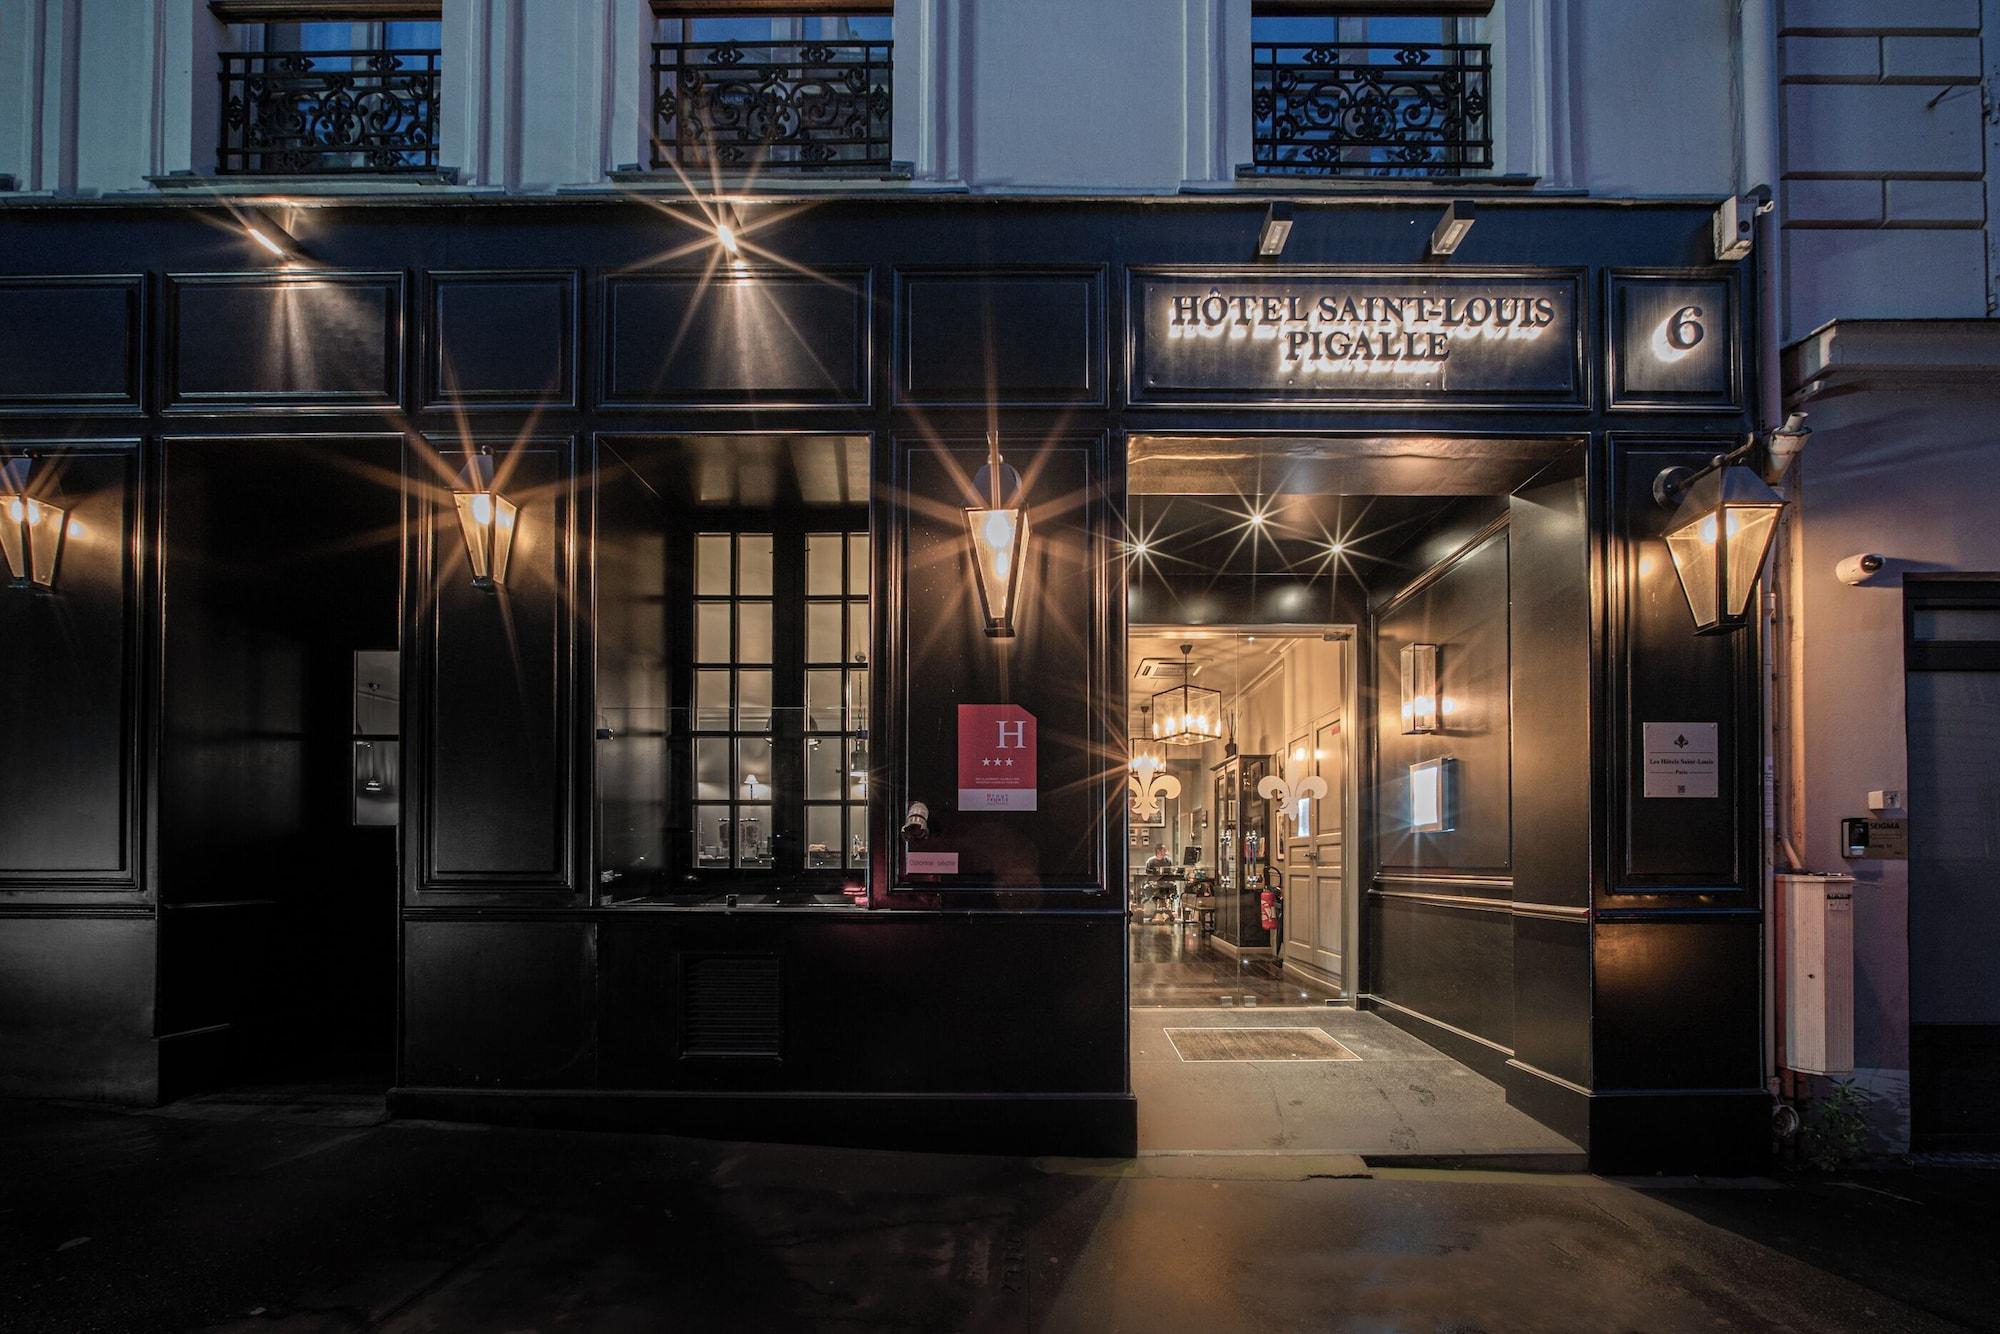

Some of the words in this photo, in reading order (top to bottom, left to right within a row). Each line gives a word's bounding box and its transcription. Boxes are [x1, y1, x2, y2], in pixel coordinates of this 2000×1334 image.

[1171, 287, 1309, 327] HÔTEL
[1316, 296, 1556, 328] SAINT-LOUIS
[1666, 306, 1704, 350] 6
[1284, 331, 1451, 362] PIGALLE
[995, 720, 1028, 749] H
